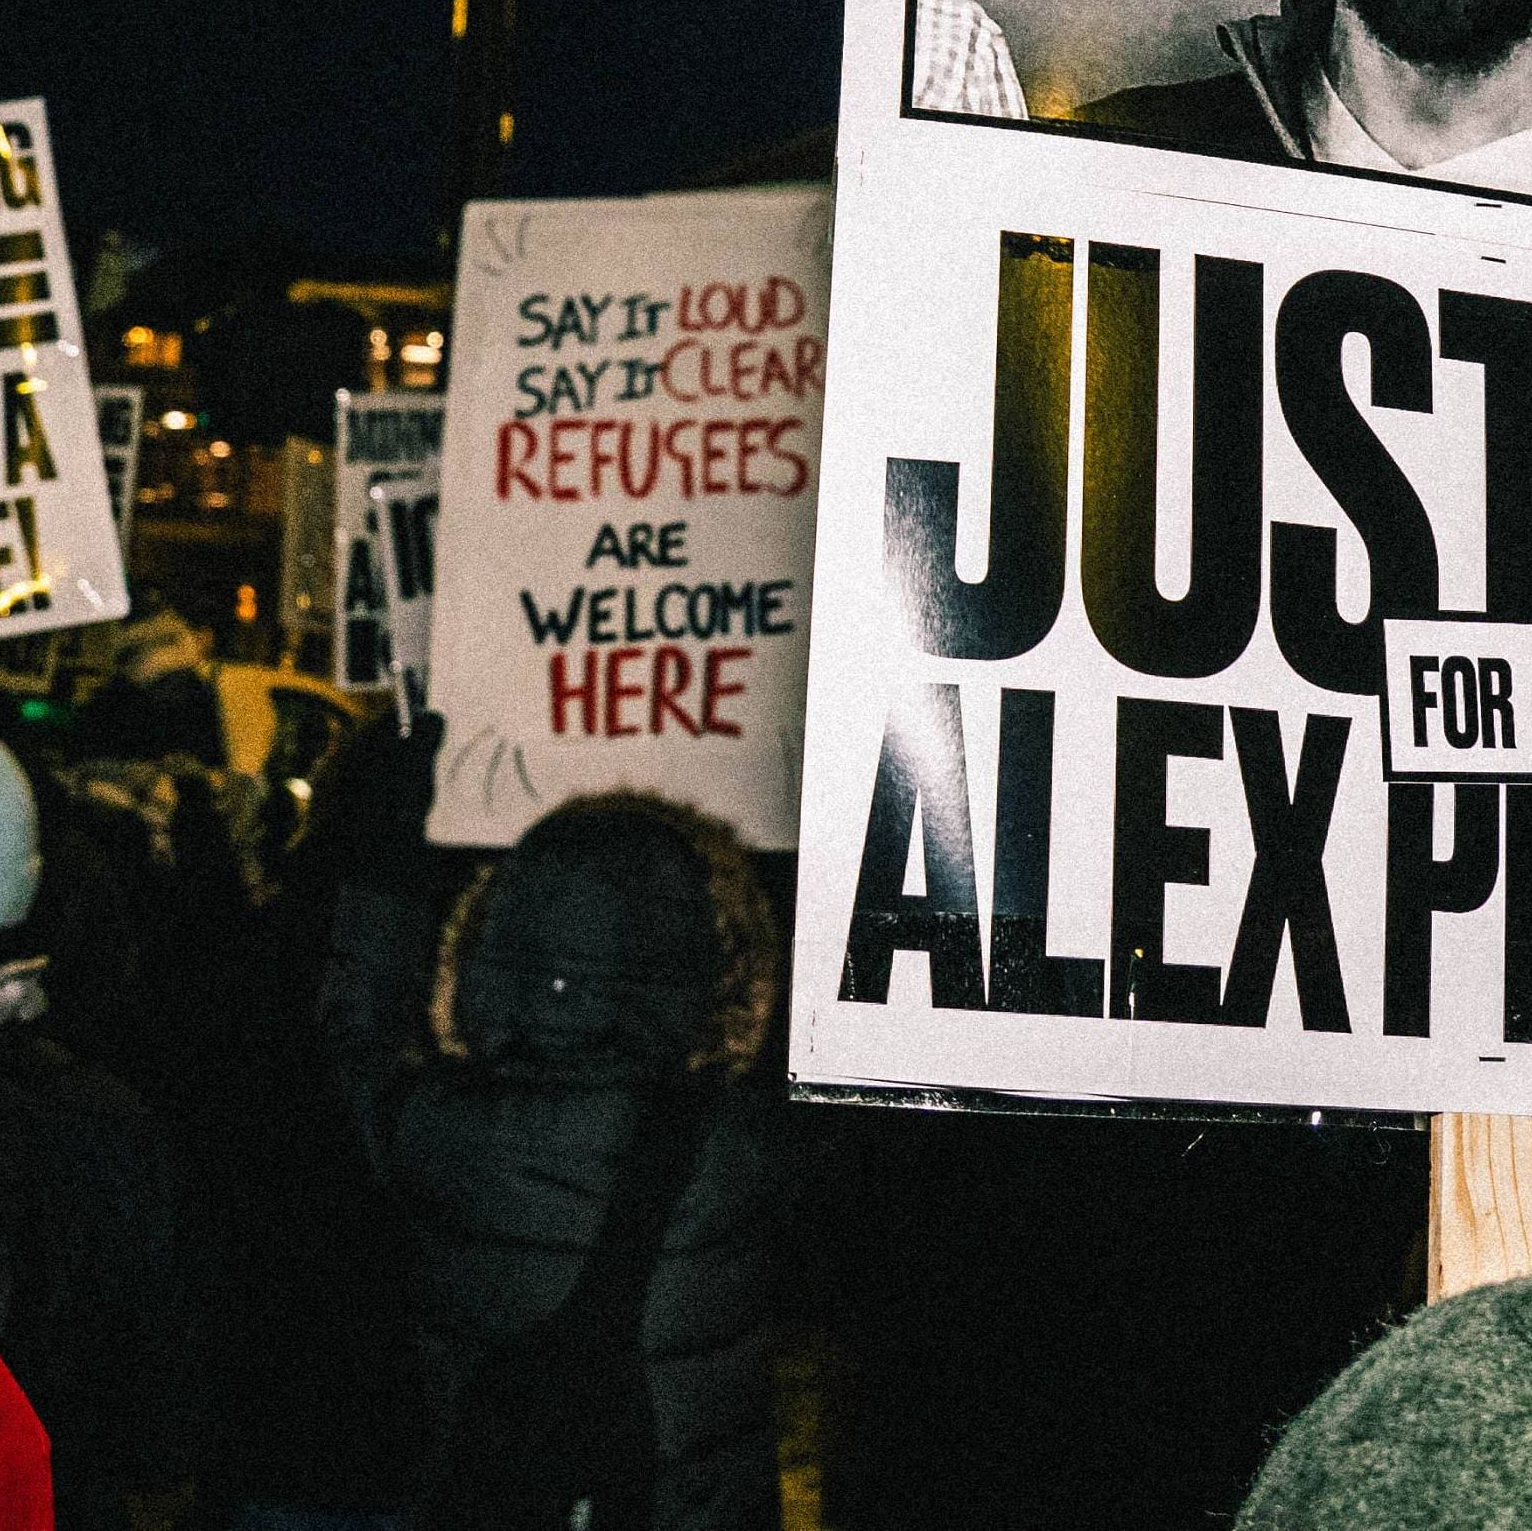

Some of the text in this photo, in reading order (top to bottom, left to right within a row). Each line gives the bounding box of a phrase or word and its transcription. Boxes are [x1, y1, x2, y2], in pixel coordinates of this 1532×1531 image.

[515, 292, 614, 351] SAY
[677, 275, 805, 335] LOUD
[514, 358, 612, 419] SAY
[659, 333, 825, 404] CLEAR
[4, 371, 58, 487] A
[495, 418, 810, 502] REFUGEES
[585, 520, 689, 569] ARE
[519, 578, 795, 645] WELCOME
[548, 644, 754, 739] HERE
[1411, 655, 1517, 752] FOR
[836, 681, 1353, 1034] ALEX
